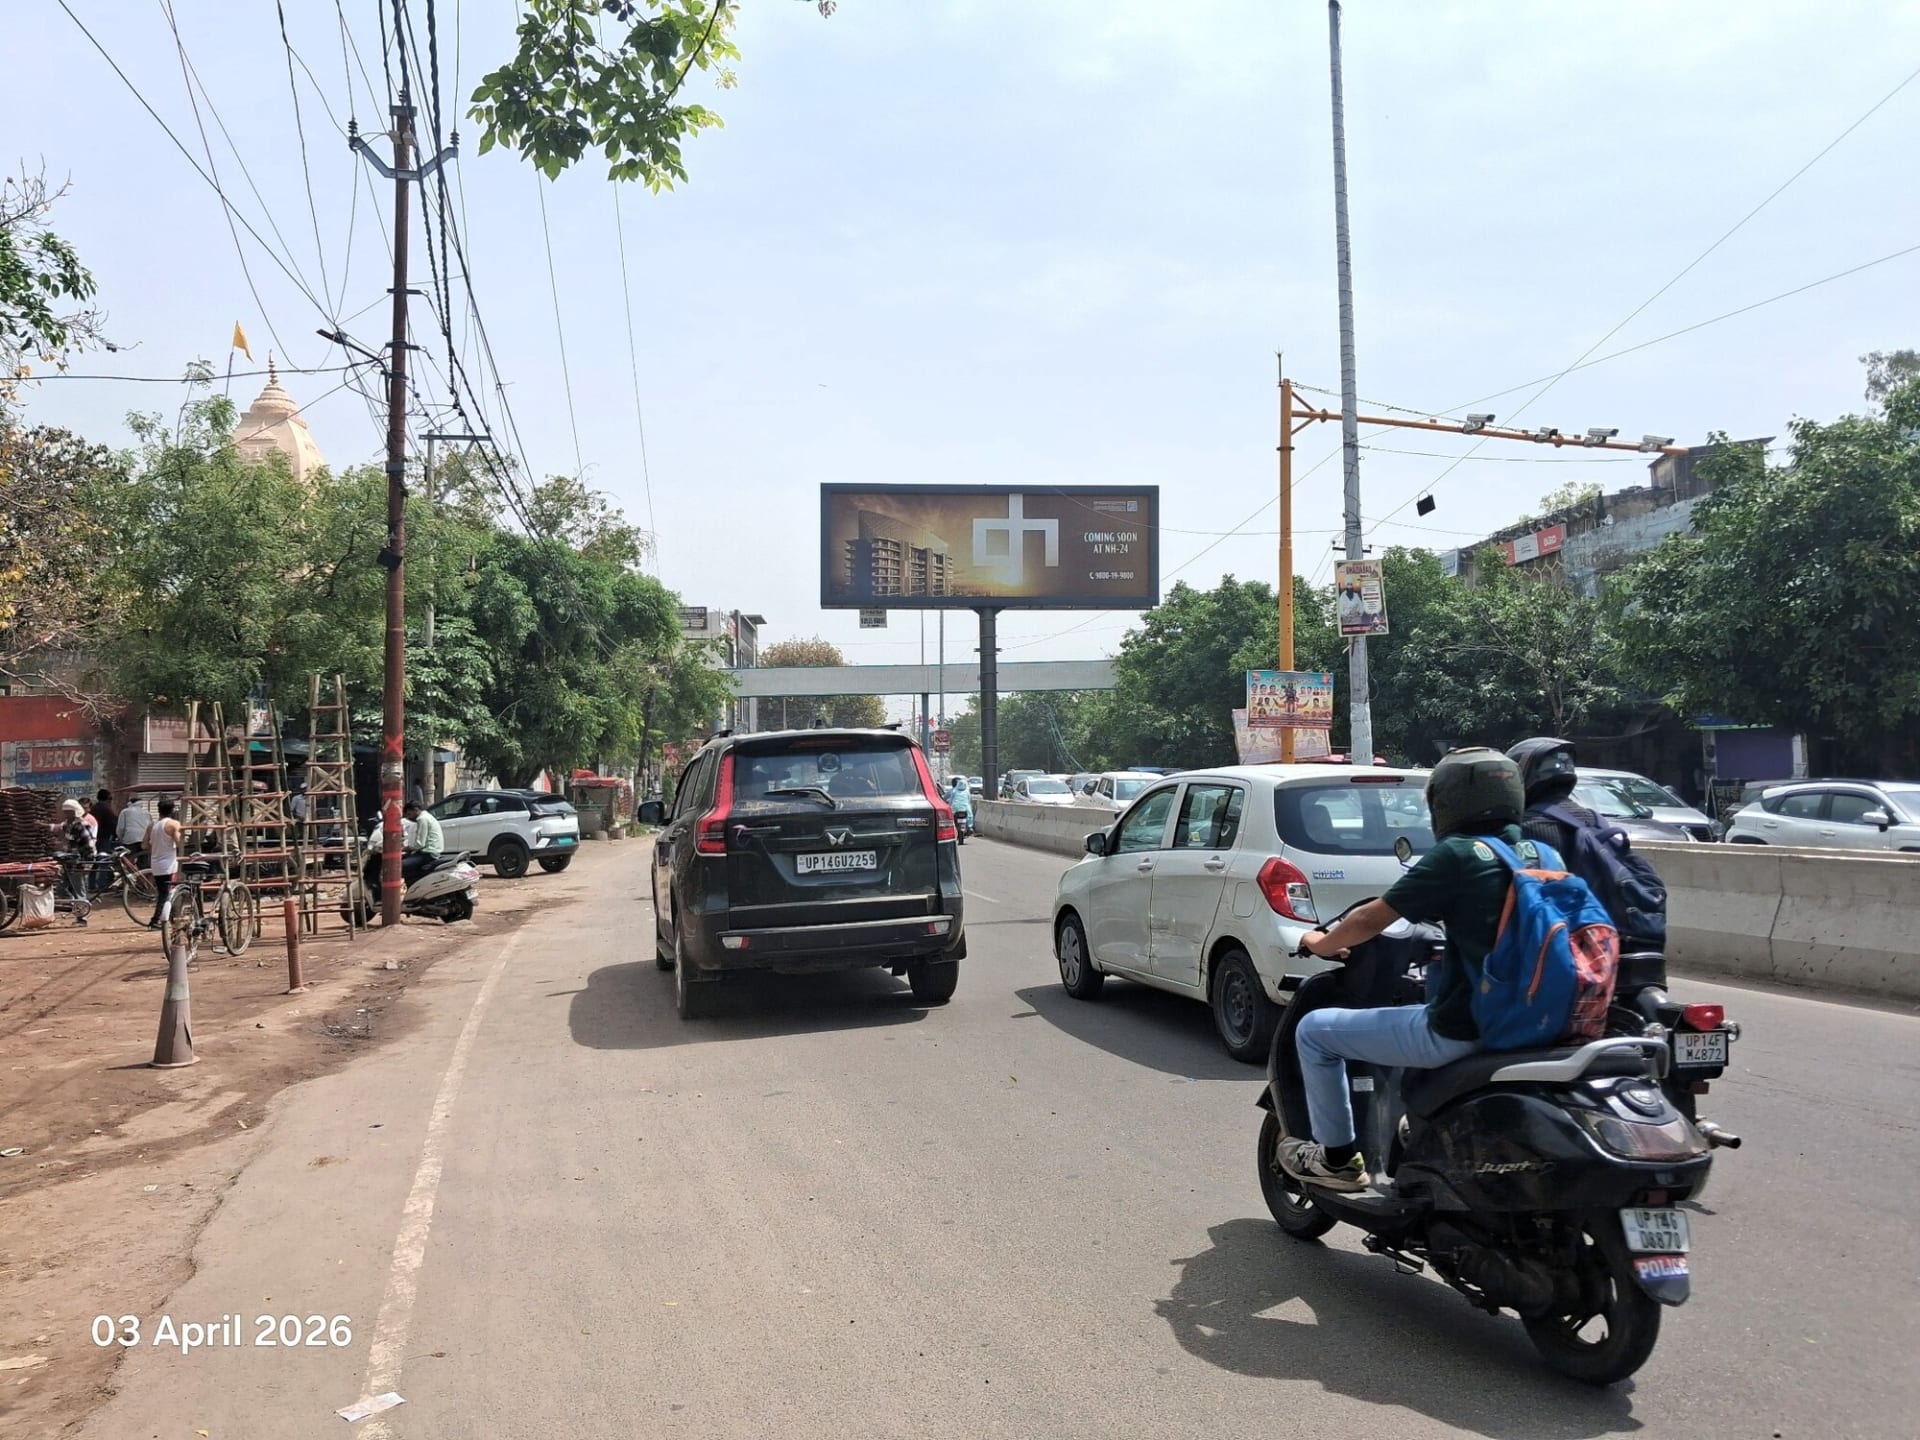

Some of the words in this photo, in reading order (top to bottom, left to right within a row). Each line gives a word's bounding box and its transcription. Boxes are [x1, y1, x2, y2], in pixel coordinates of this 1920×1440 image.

[1083, 532, 1115, 543] COMING
[1116, 532, 1138, 543] SOON
[1093, 543, 1103, 554] AT
[1104, 543, 1129, 554] NH-24
[35, 750, 86, 768] SERVO
[805, 854, 875, 869] UP14GU2259
[1639, 1258, 1689, 1279] POLICE
